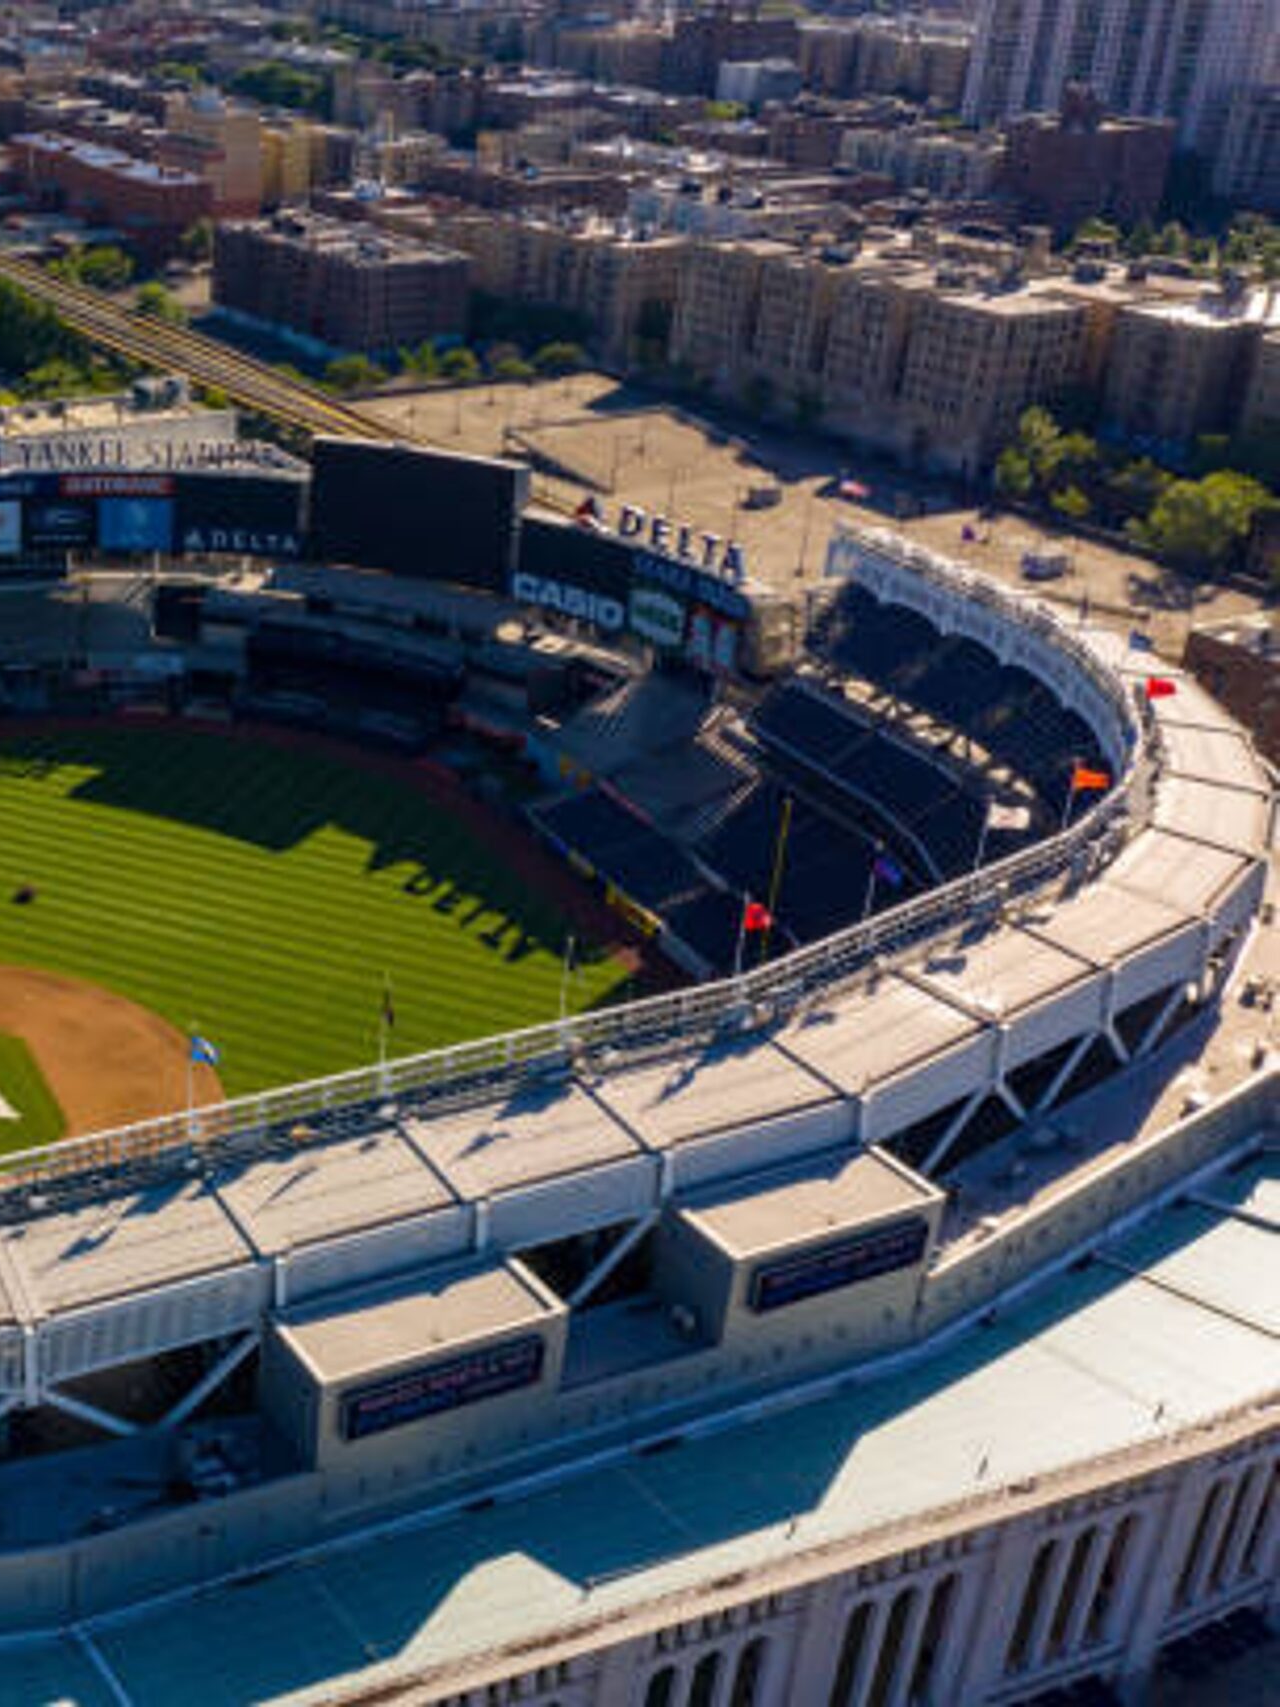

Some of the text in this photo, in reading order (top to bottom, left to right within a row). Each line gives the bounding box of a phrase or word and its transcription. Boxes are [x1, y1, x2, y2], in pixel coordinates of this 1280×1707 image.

[210, 528, 300, 556] DELTA
[618, 504, 746, 586] DELTA
[513, 572, 626, 630] CASIO
